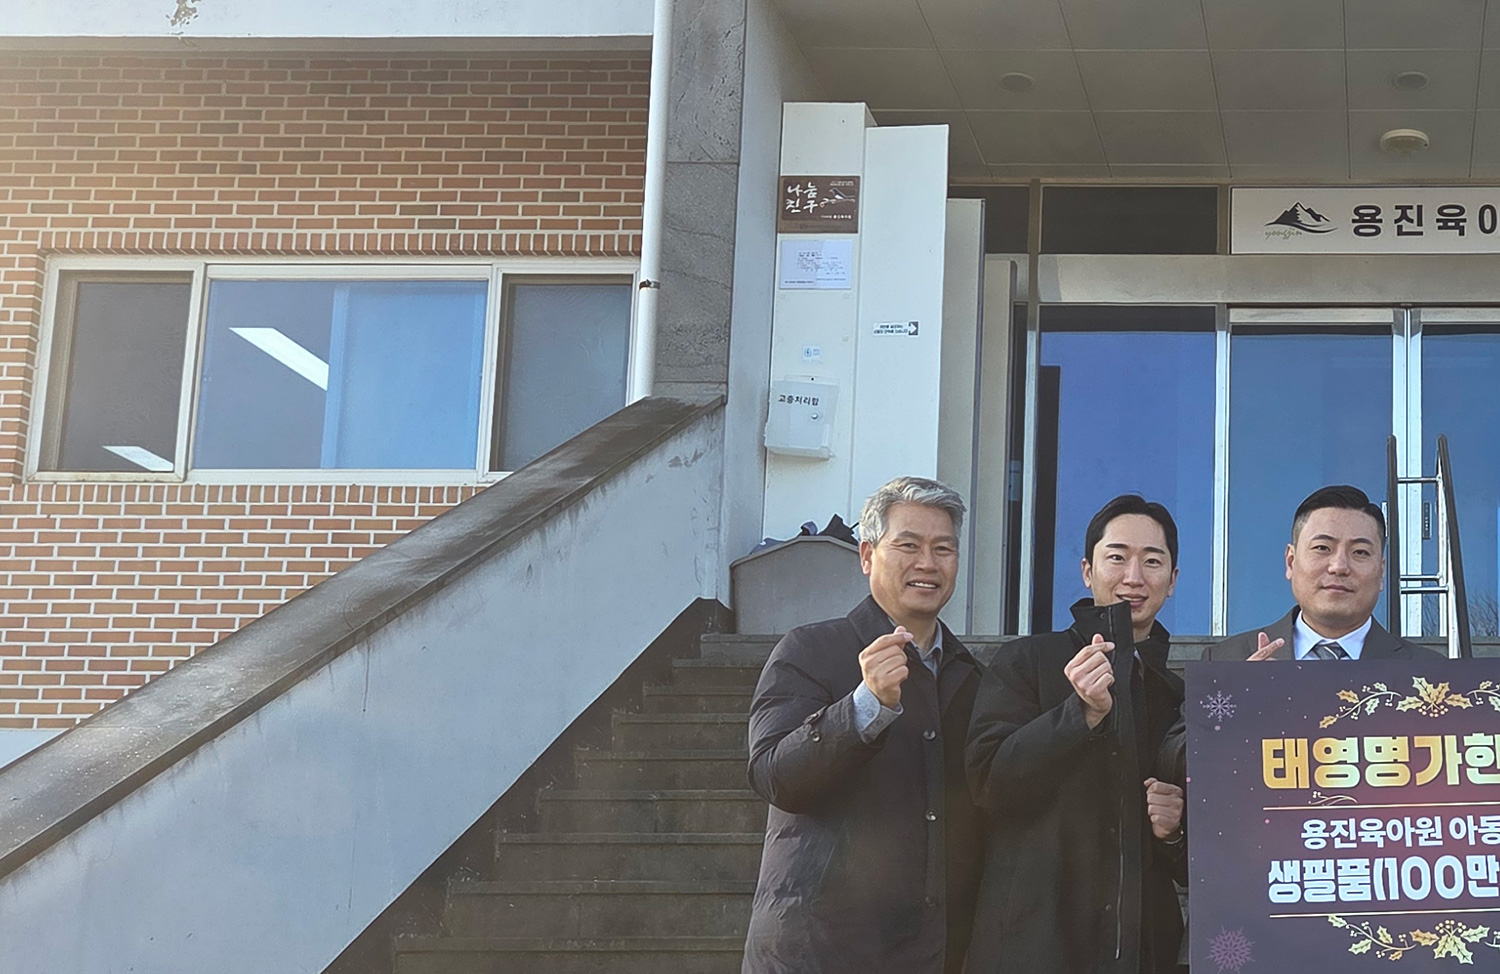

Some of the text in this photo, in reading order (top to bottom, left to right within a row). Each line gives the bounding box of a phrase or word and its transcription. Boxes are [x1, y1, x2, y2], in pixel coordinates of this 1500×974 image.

[787, 182, 818, 199] 나눔
[786, 198, 818, 214] 친구
[1300, 814, 1444, 850] 용진육아원
